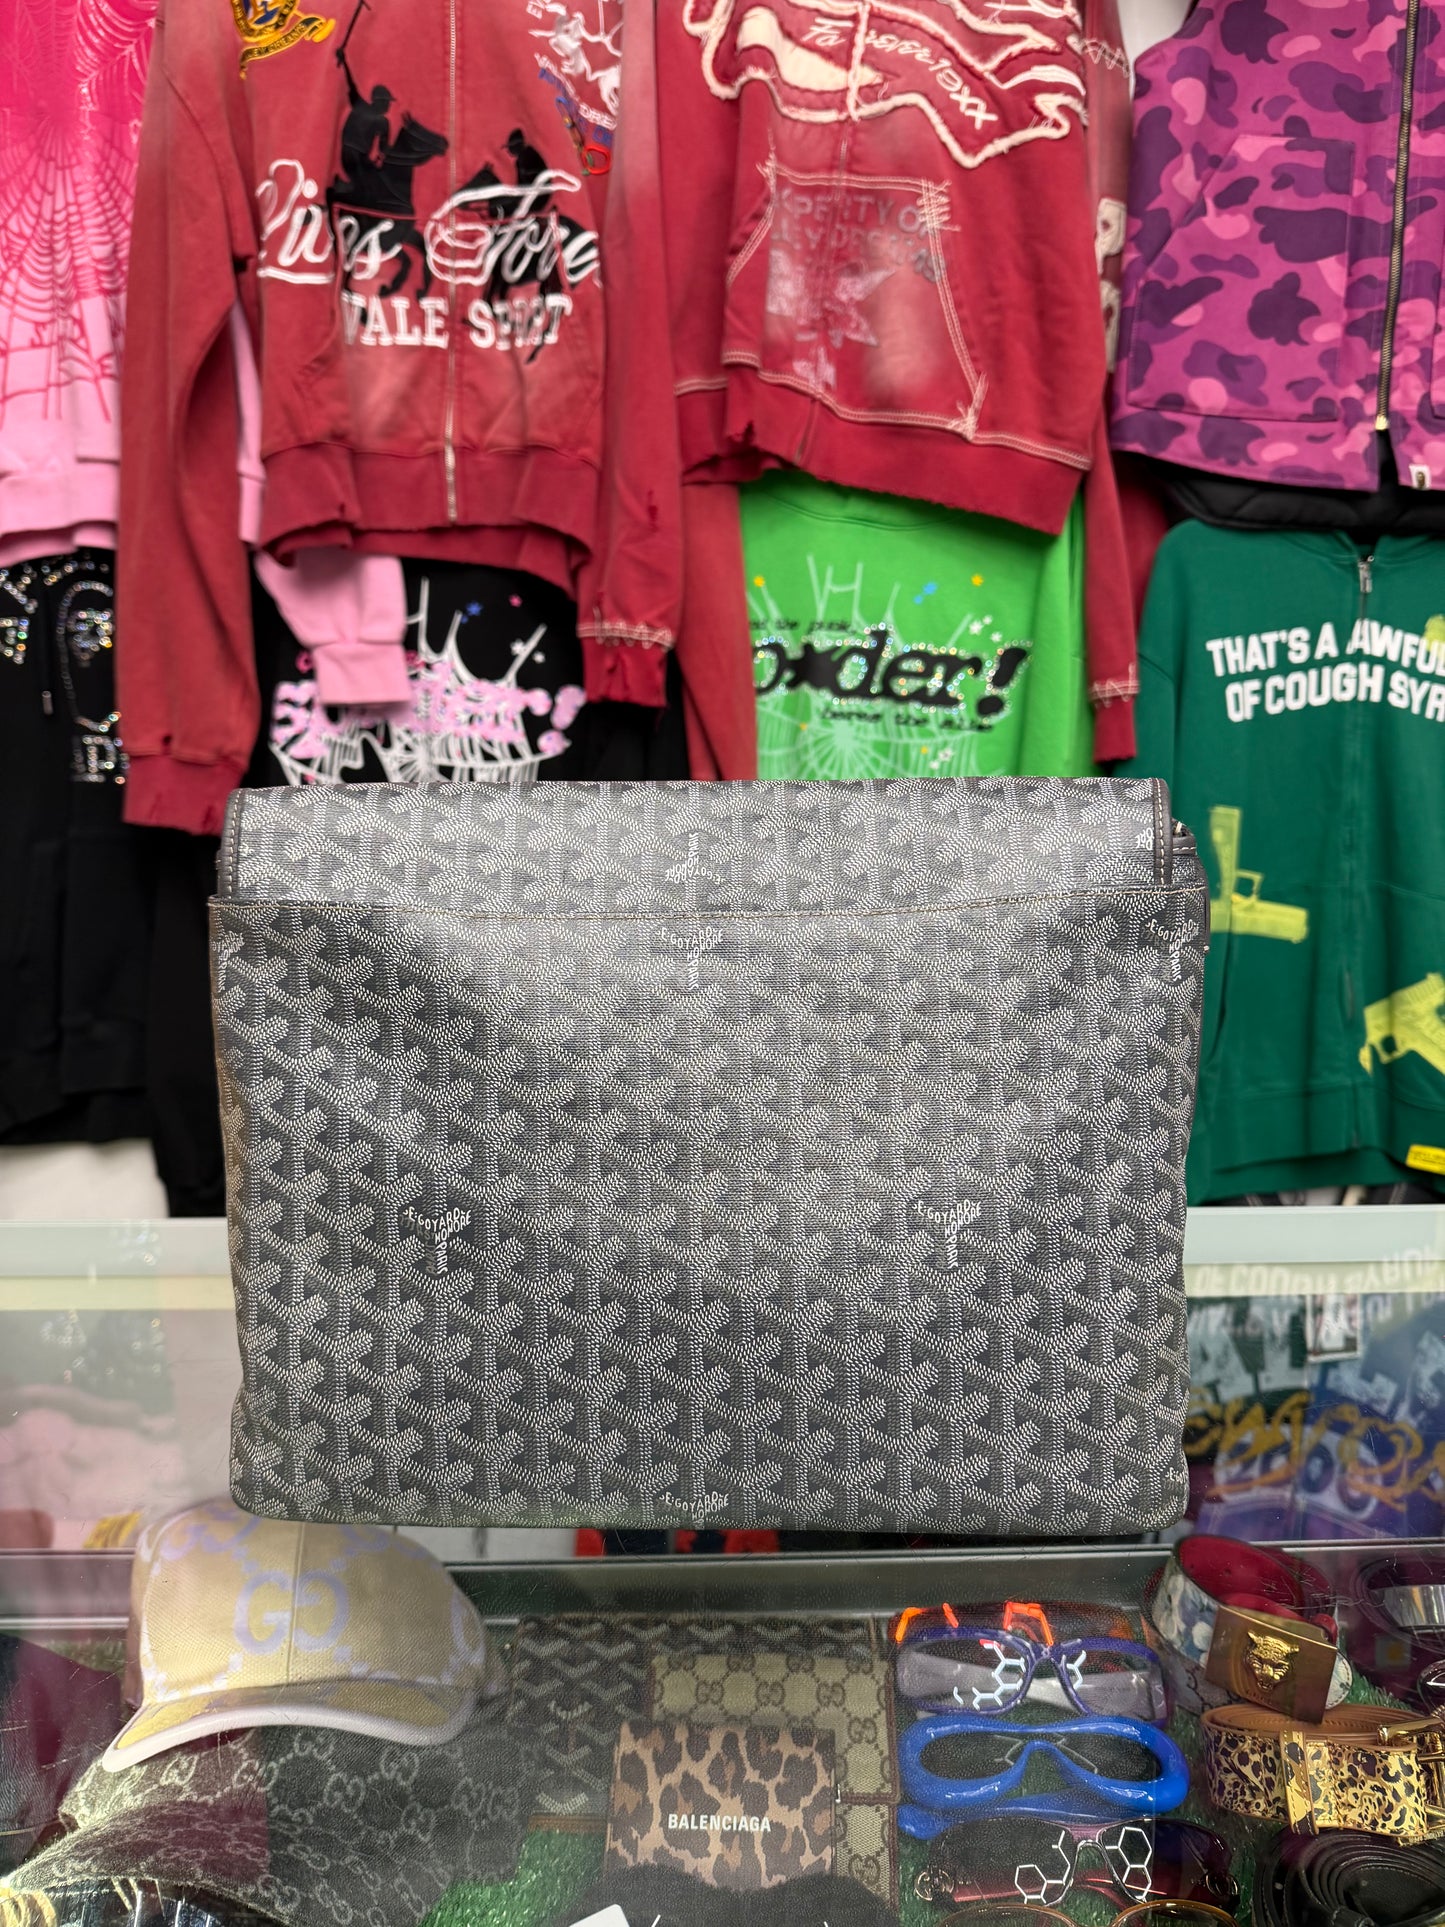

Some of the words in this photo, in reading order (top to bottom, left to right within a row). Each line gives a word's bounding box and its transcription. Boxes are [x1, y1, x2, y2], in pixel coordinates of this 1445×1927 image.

[341, 291, 449, 349] VALE
[1206, 627, 1310, 677] THAT'S
[1314, 621, 1339, 660] A
[1225, 678, 1262, 722] OF
[1265, 661, 1385, 715] COUGH
[668, 1814, 771, 1832] BALENCIAGA
